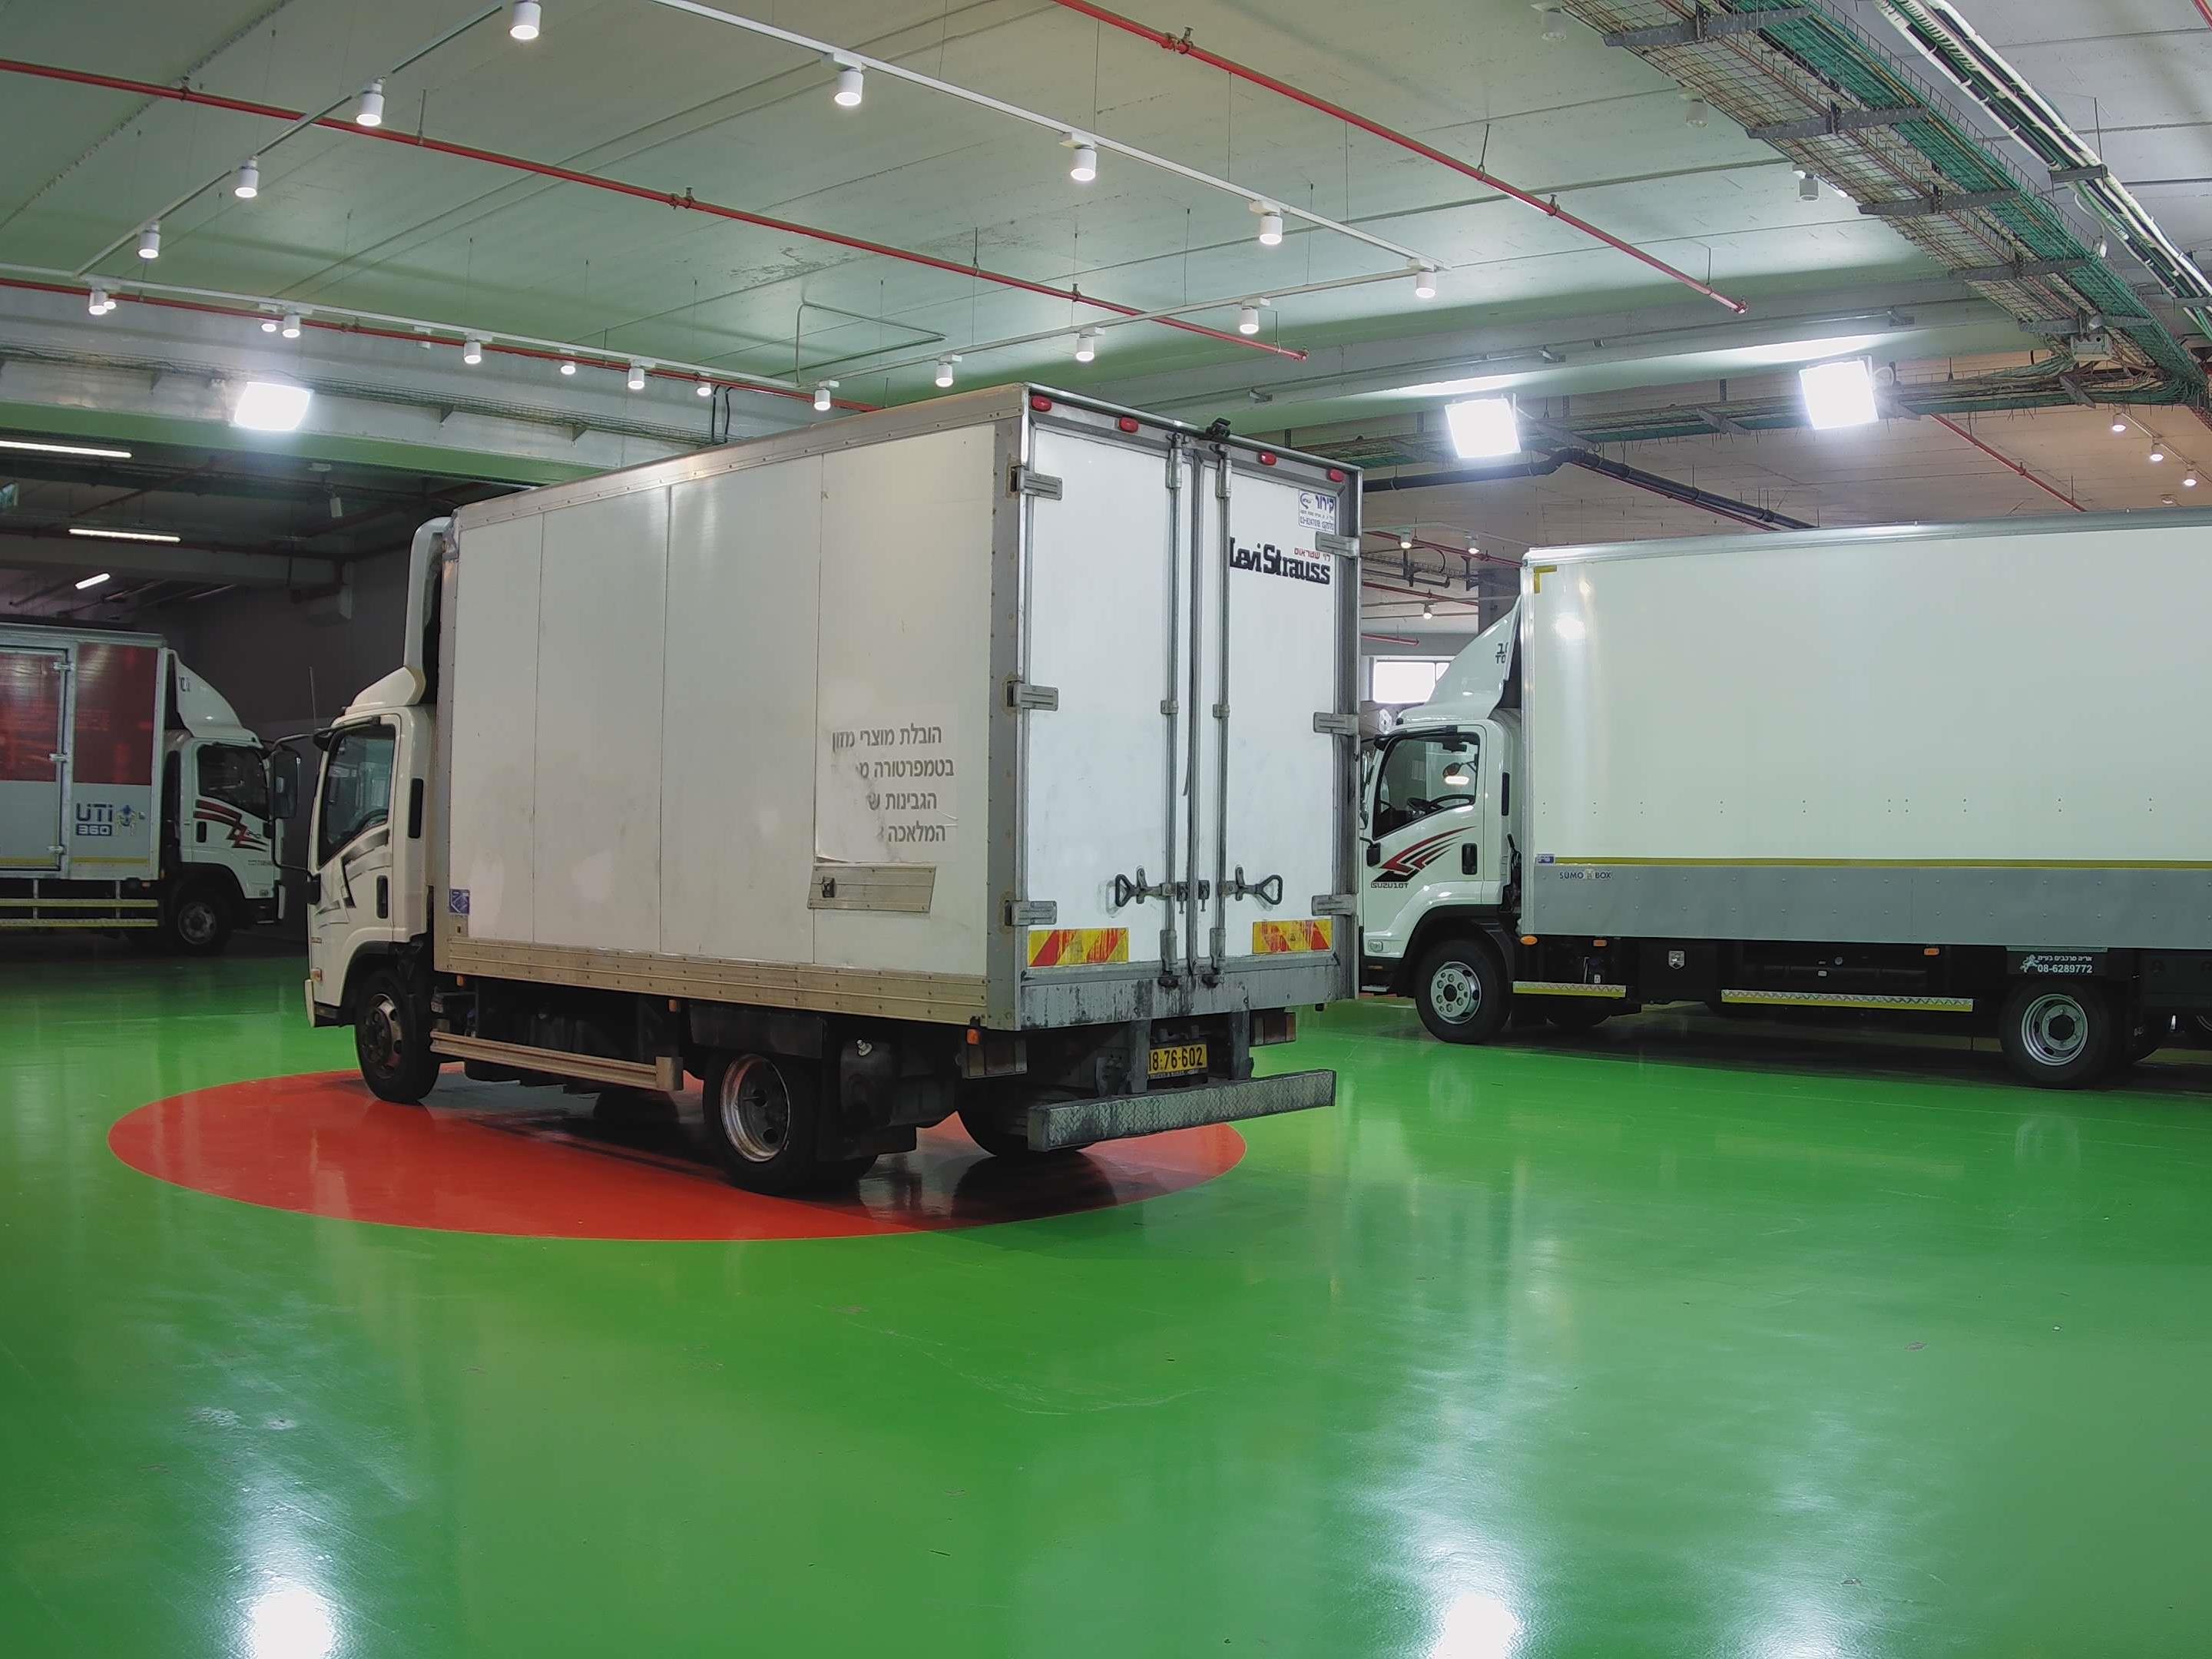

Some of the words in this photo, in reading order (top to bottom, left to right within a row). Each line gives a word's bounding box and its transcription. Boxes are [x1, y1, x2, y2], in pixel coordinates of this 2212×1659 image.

[1315, 495, 1335, 514] קירור
[1229, 536, 1263, 572] Levi
[1263, 543, 1331, 585] Strauss
[832, 730, 856, 753] מזון
[859, 729, 896, 747] מוצרי
[899, 723, 942, 745] הובלת
[874, 759, 955, 778] בטמפרטורה
[885, 792, 937, 810] הגבינות
[78, 824, 111, 836] 360
[888, 820, 945, 843] המלאכה
[1559, 871, 1584, 879] SUMO
[1595, 871, 1611, 879] BOX
[2037, 964, 2093, 974] 08-6289772
